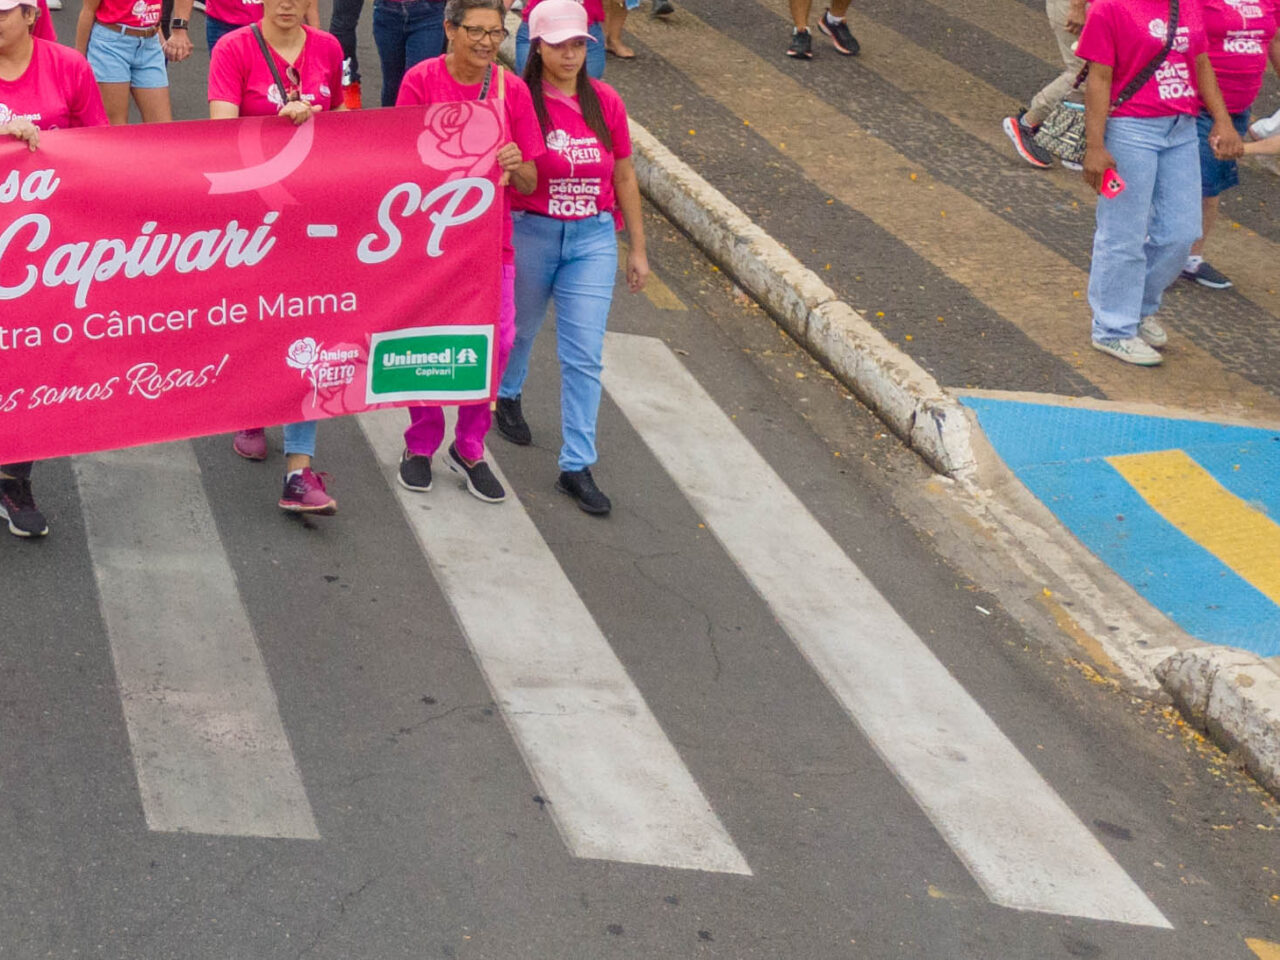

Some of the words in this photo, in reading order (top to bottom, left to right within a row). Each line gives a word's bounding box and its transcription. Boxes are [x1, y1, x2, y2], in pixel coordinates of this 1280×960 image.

[572, 147, 600, 159] PEITO
[549, 182, 600, 195] pétalas
[548, 199, 598, 216] ROSA
[306, 223, 338, 238] -
[356, 177, 495, 264] SP
[53, 321, 73, 343] o
[83, 308, 199, 341] Câncer
[207, 297, 247, 326] de
[258, 291, 358, 319] Mama
[320, 348, 359, 362] Amigas
[383, 348, 451, 367] Unimed
[319, 365, 355, 382] PEITO
[415, 367, 452, 377] Capivari
[27, 377, 120, 414] somos
[126, 353, 231, 401] Rosas!
